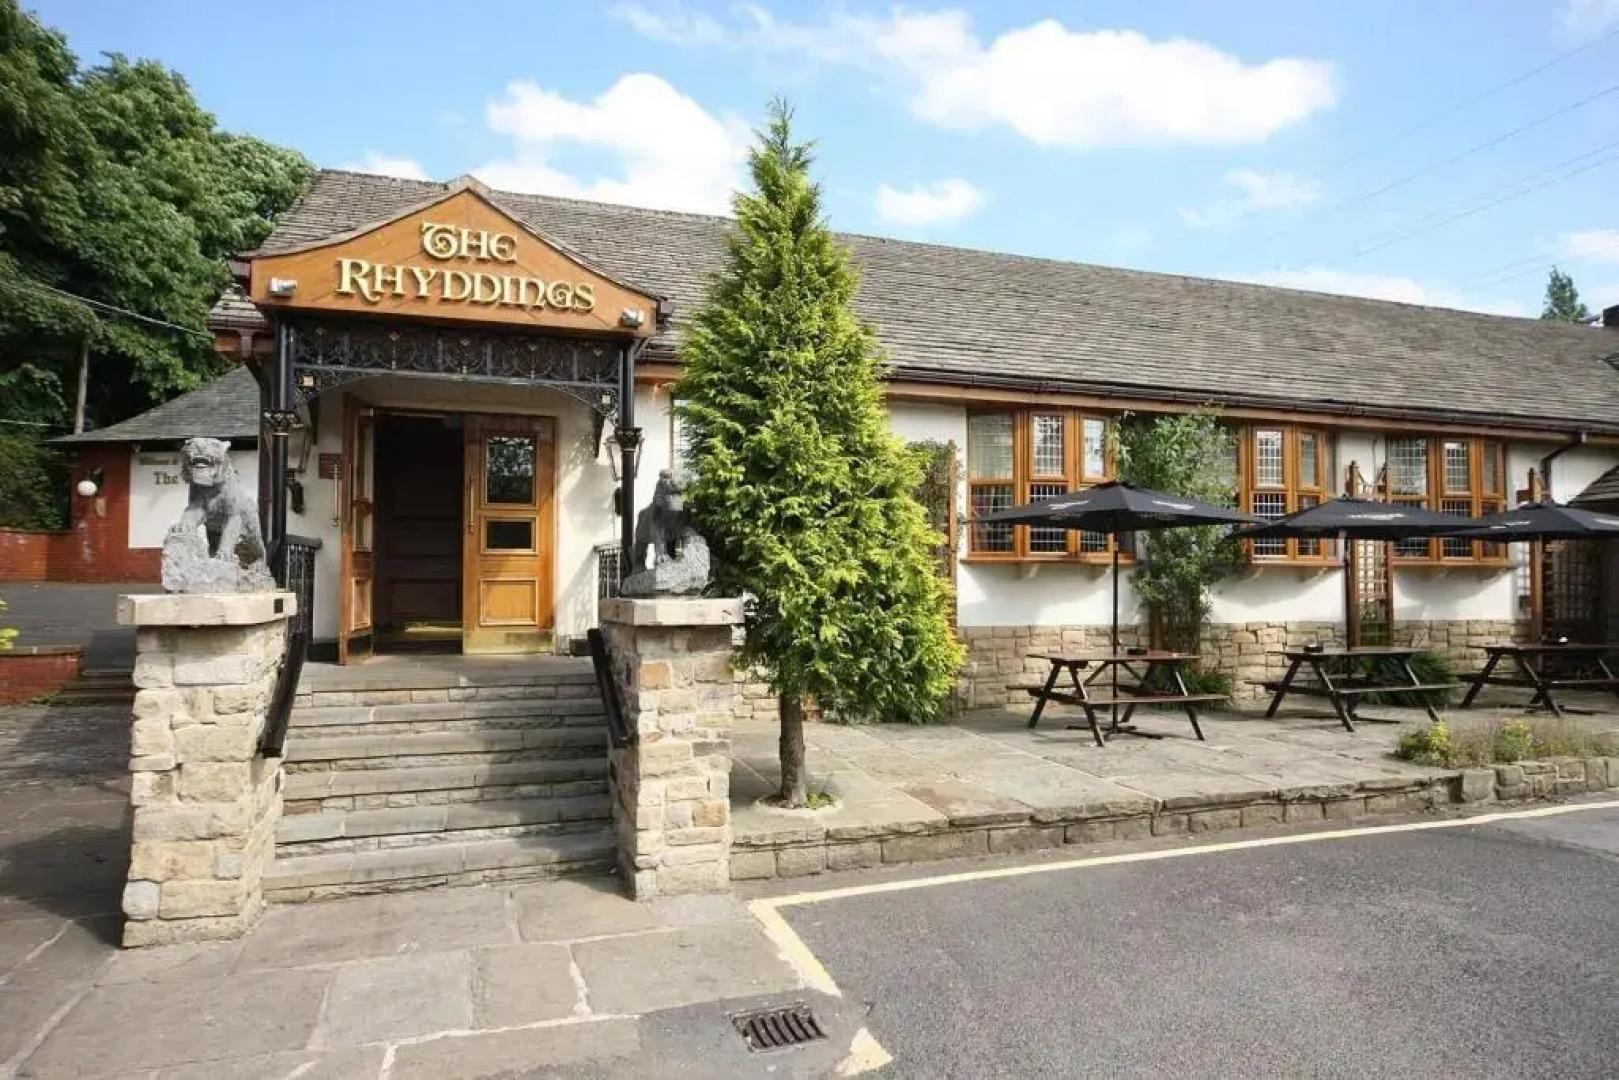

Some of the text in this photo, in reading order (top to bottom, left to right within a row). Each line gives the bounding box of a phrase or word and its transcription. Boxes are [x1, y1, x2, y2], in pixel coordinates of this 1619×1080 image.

[421, 221, 518, 263] THE
[336, 257, 595, 312] RHYDDINGS
[153, 470, 178, 485] The
